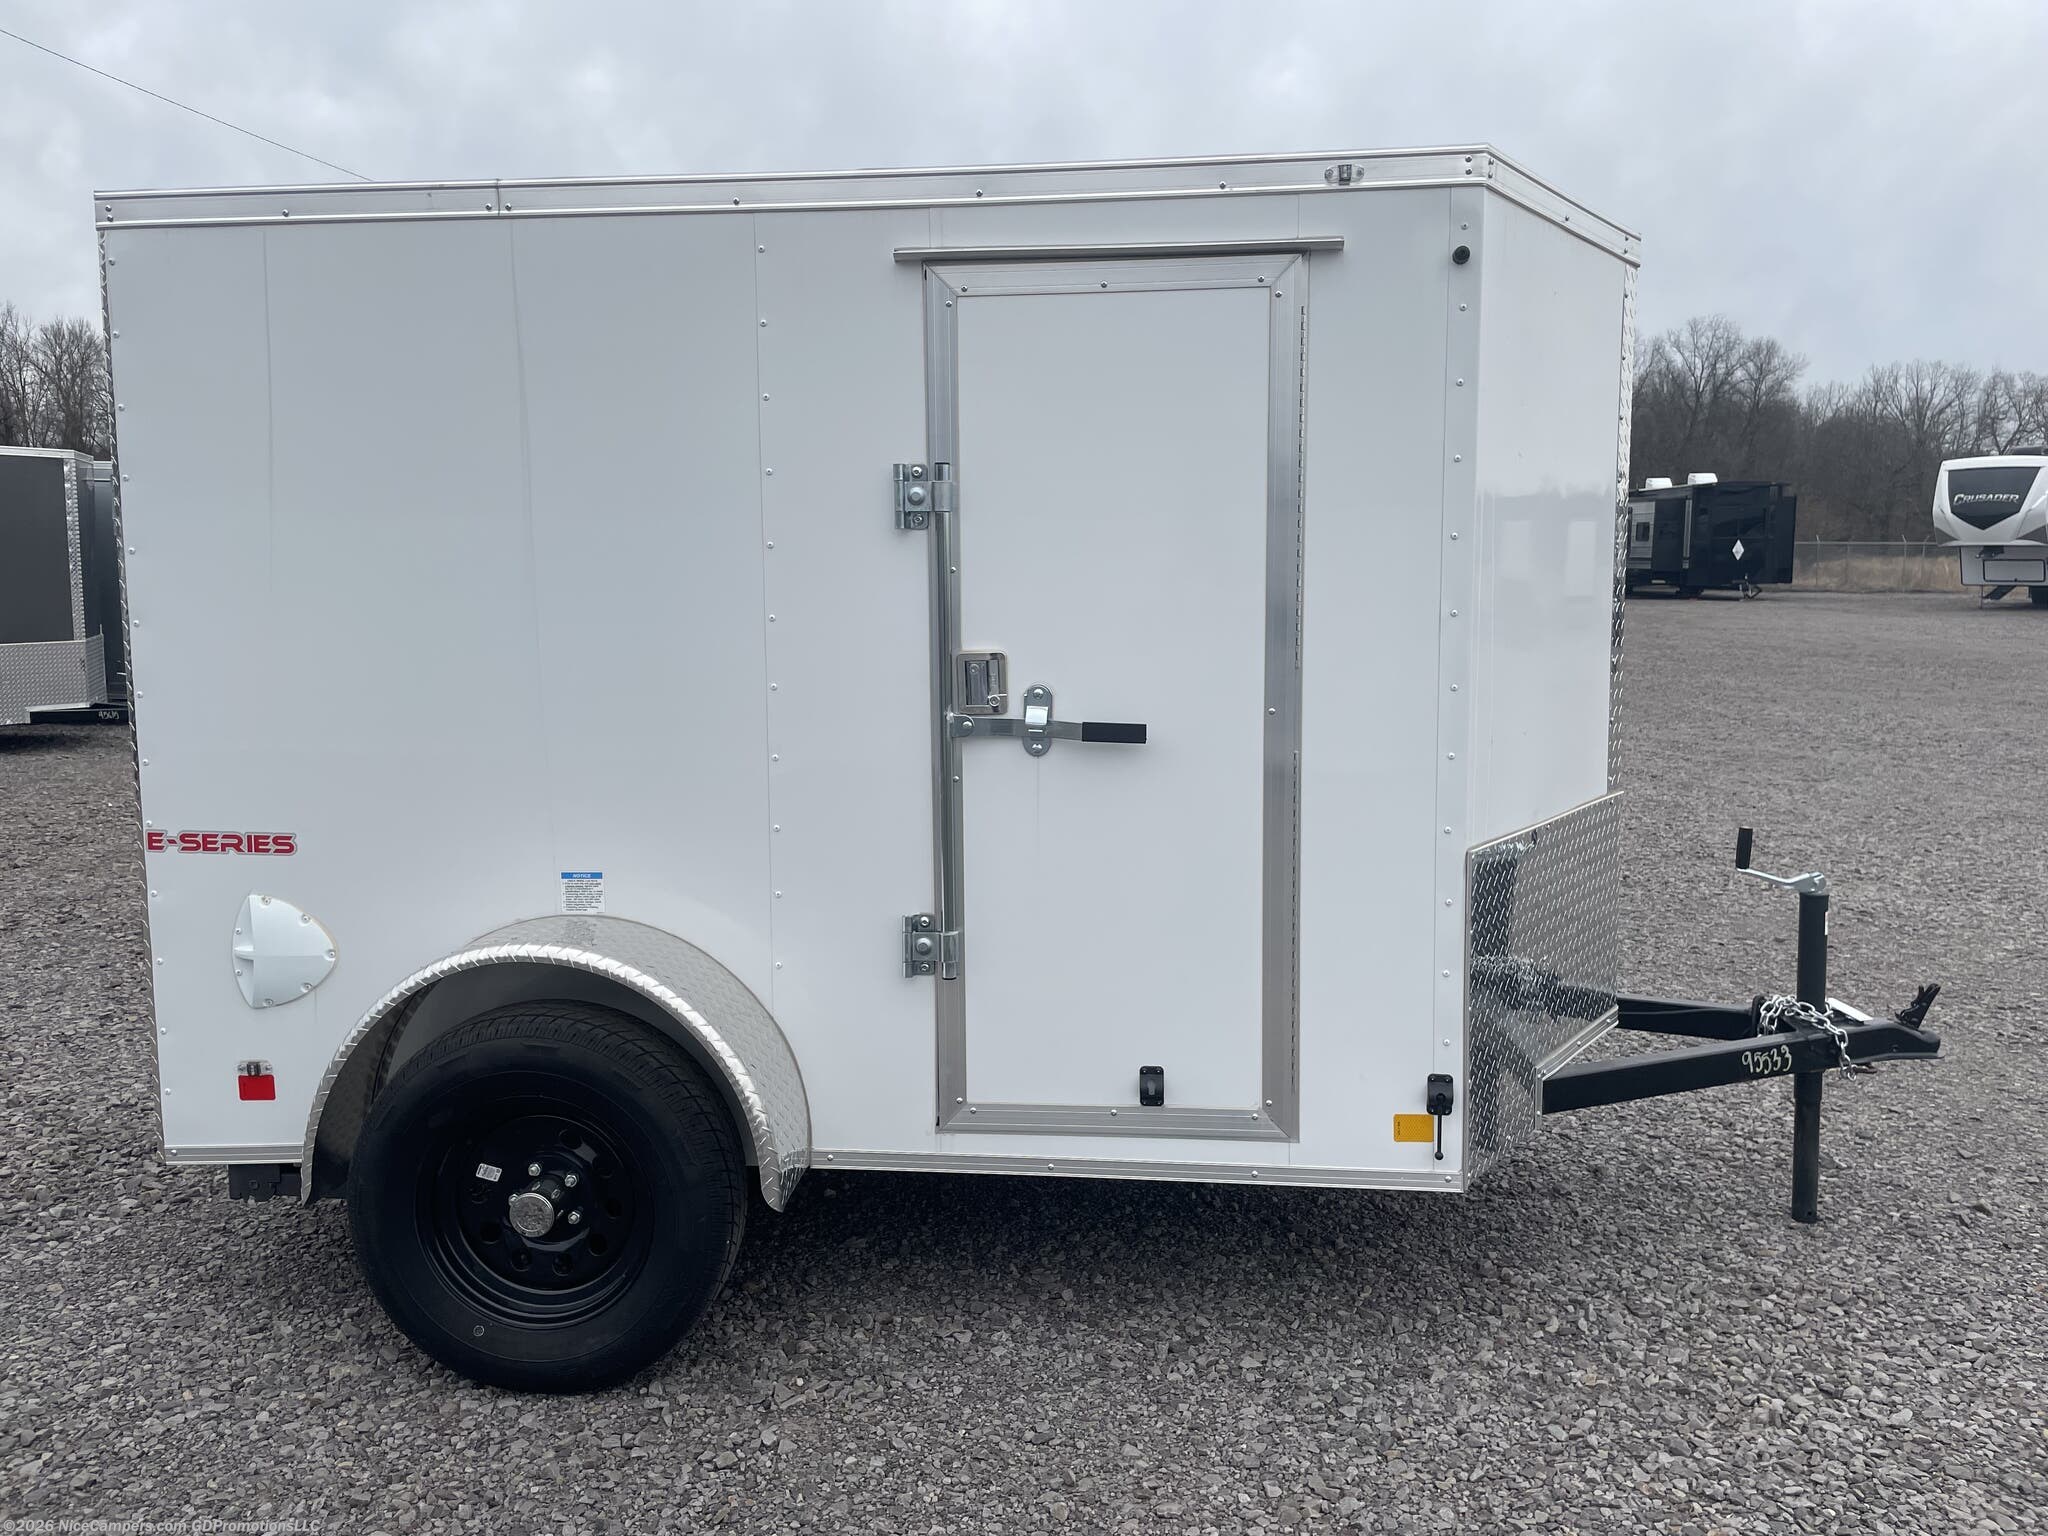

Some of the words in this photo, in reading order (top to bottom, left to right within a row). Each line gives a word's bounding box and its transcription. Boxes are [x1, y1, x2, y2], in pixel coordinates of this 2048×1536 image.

[1953, 493, 2019, 505] CRUSADER
[146, 831, 296, 854] E-SERIES
[1742, 1044, 1792, 1075] 95533
